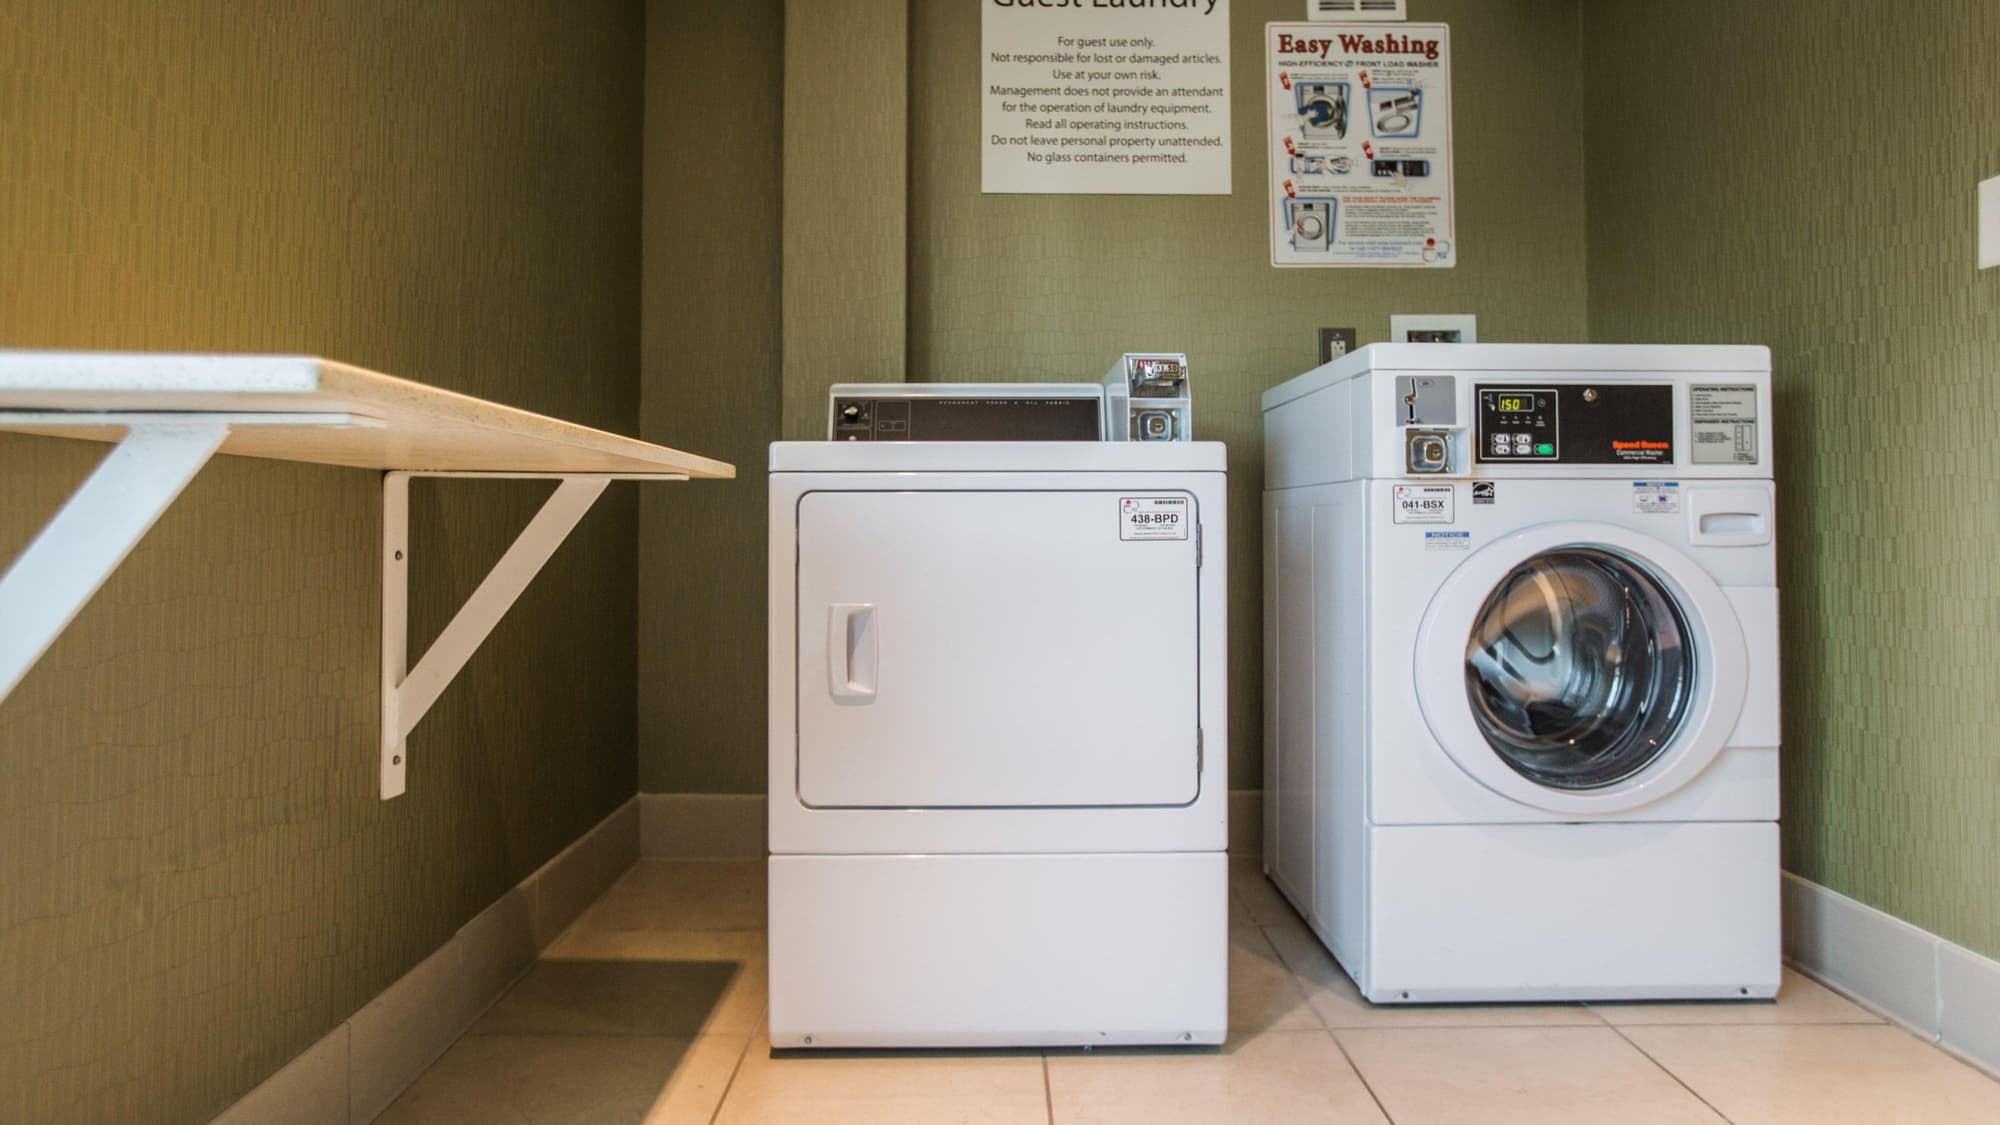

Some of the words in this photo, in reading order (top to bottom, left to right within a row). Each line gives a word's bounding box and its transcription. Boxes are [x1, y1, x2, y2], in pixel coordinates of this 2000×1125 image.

[1058, 36, 1075, 47] For
[1077, 38, 1107, 49] guest
[1110, 39, 1128, 47] use
[1130, 37, 1156, 49] only.
[1278, 34, 1332, 59] Easy
[1338, 34, 1439, 60] Washing
[991, 53, 1011, 63] Not
[1013, 53, 1075, 65] responsible
[1077, 53, 1092, 63] for
[1094, 53, 1113, 63] lost
[1115, 55, 1127, 64] or
[1129, 53, 1180, 65] damaged
[1182, 54, 1222, 64] articles.
[1053, 70, 1073, 80] Use
[1075, 71, 1085, 80] at
[1088, 72, 1112, 82] your
[1114, 72, 1138, 80] own
[1140, 70, 1161, 80] risk.
[990, 86, 1061, 98] Management
[1064, 86, 1090, 97] does
[1092, 87, 1110, 97] not
[1113, 86, 1154, 98] provide
[1156, 88, 1169, 97] an
[1171, 87, 1223, 97] attendant
[1002, 102, 1018, 113] for
[1020, 102, 1038, 113] the
[1040, 103, 1092, 115] operation
[1094, 102, 1106, 113] of
[1108, 102, 1149, 115] laundry
[1151, 103, 1211, 115] equipment.
[1026, 119, 1053, 129] Read
[1055, 119, 1067, 129] all
[1070, 120, 1122, 132] operating
[1124, 119, 1188, 130] instructions.
[992, 135, 1008, 145] Do
[1010, 136, 1028, 146] not
[1031, 135, 1059, 146] leave
[1061, 136, 1107, 148] personal
[1109, 137, 1156, 149] property
[1159, 136, 1223, 147] unattended.
[1027, 152, 1043, 162] No
[1046, 152, 1072, 164] glass
[1074, 152, 1130, 163] containers
[1132, 153, 1188, 164] permitted.
[1402, 500, 1445, 509] 041-BSX
[1131, 513, 1179, 524] 438-BPD
